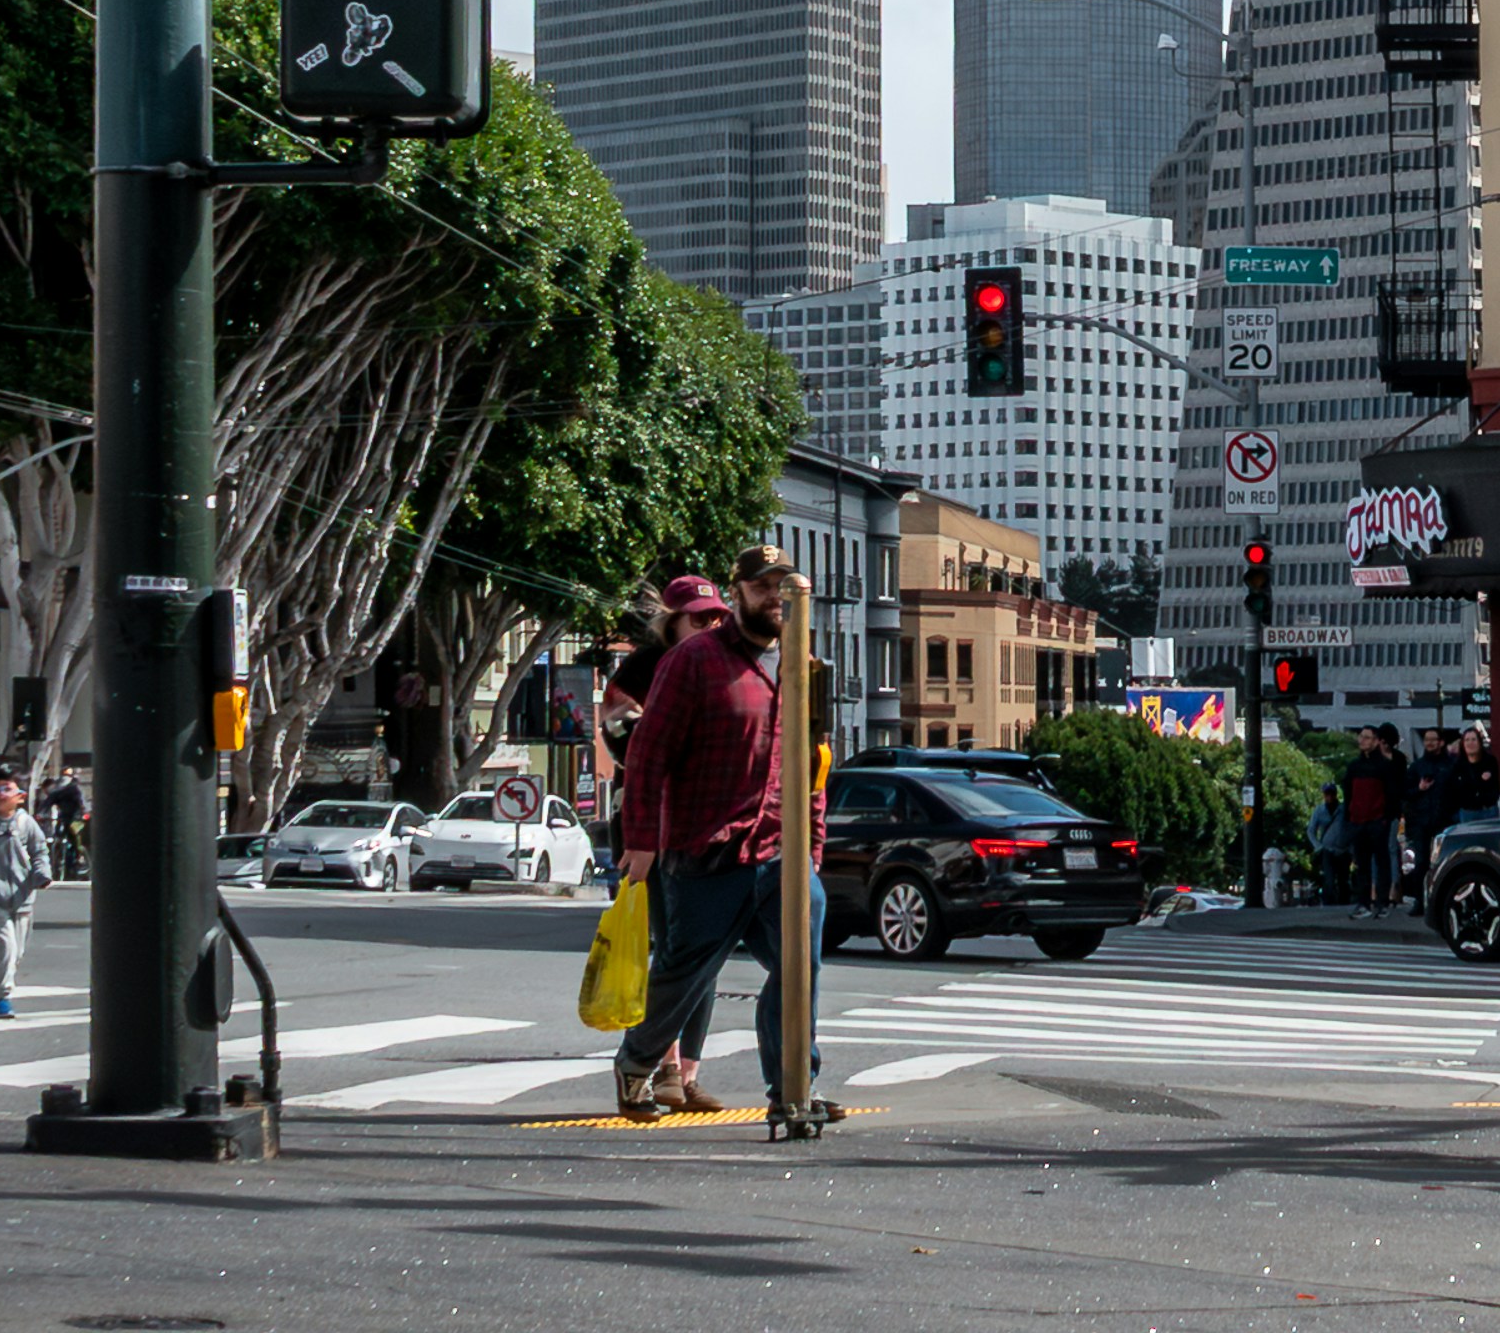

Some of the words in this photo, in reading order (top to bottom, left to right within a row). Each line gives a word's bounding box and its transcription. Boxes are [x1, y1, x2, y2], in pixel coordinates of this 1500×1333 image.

[1229, 258, 1311, 273] FREEWAY
[1226, 314, 1275, 326] SPEED
[1232, 329, 1268, 341] LIMIT
[1229, 344, 1272, 370] 20
[1228, 491, 1245, 505] ON
[1251, 491, 1276, 504] RED
[1268, 629, 1349, 644] BROADWAY
